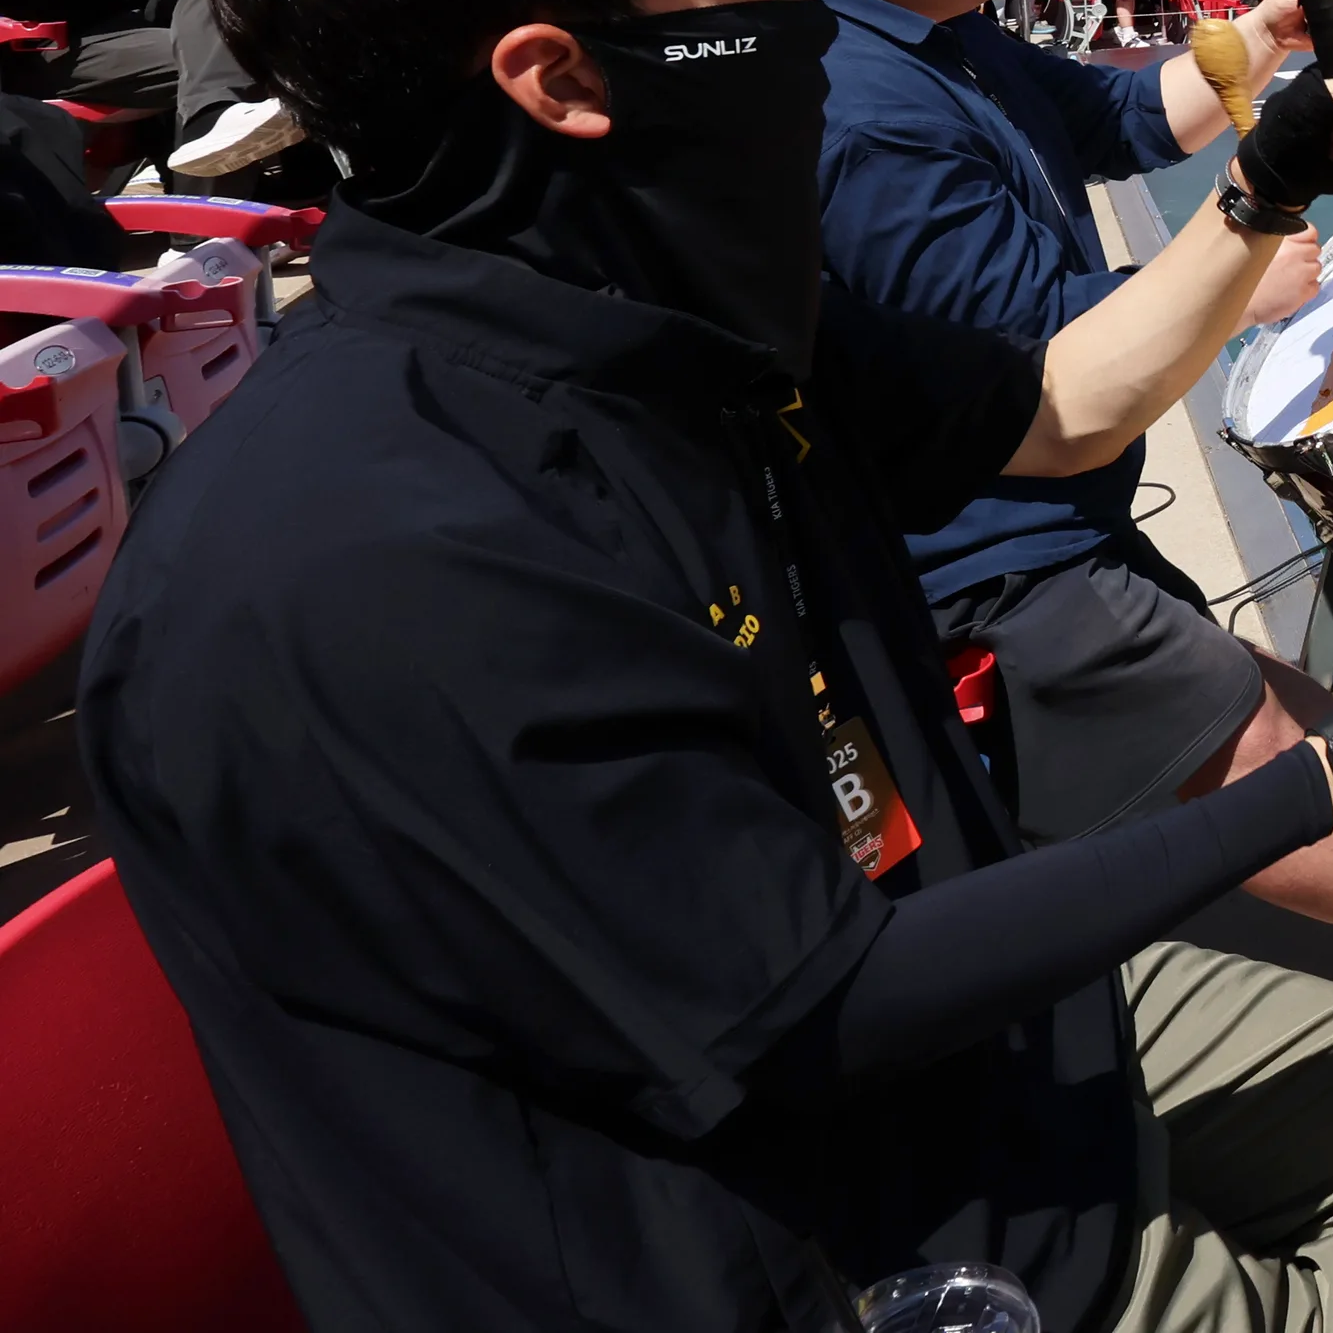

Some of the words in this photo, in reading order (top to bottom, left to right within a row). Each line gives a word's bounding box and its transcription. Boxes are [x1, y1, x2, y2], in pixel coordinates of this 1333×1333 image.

[664, 36, 757, 62] SUNLIZ
[787, 564, 801, 597] TIGERS
[797, 598, 806, 617] KIA
[832, 772, 874, 822] B
